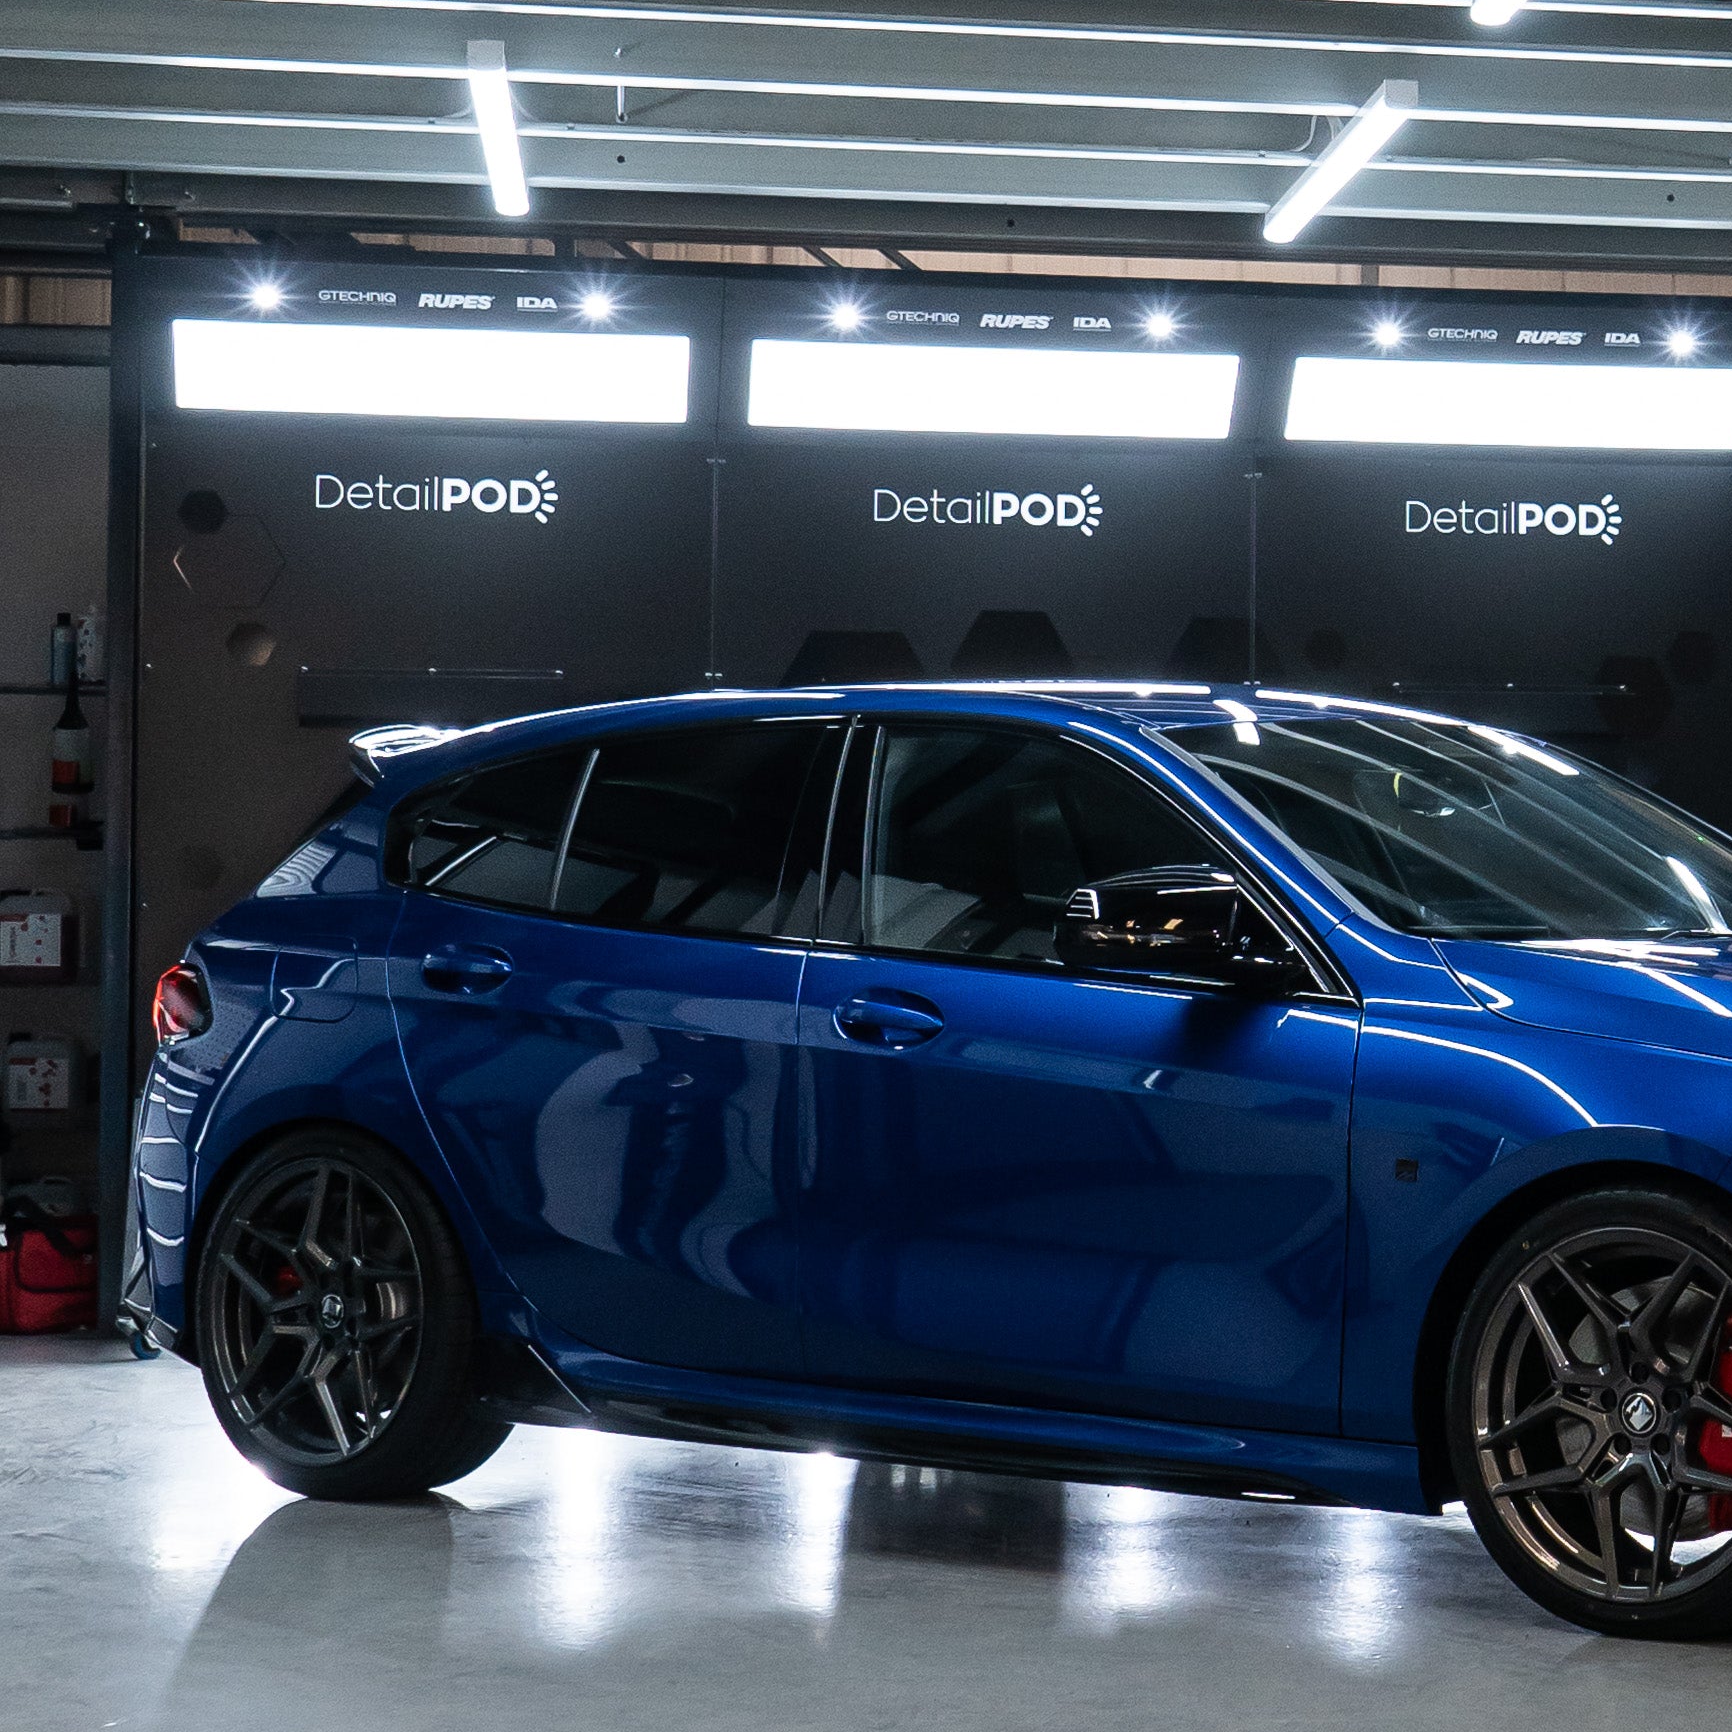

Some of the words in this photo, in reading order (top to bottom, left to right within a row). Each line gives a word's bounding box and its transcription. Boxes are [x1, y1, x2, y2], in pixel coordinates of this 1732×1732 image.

[418, 293, 495, 310] RUPES
[516, 296, 558, 309] IDA
[980, 313, 1053, 330] RUPES
[1073, 316, 1112, 328] IDA
[1515, 330, 1586, 345] RUPES
[1604, 332, 1641, 344] IDA
[315, 474, 542, 514] DetailPOD
[873, 488, 1086, 528] DetailPOD
[1405, 500, 1607, 537] DetailPOD
